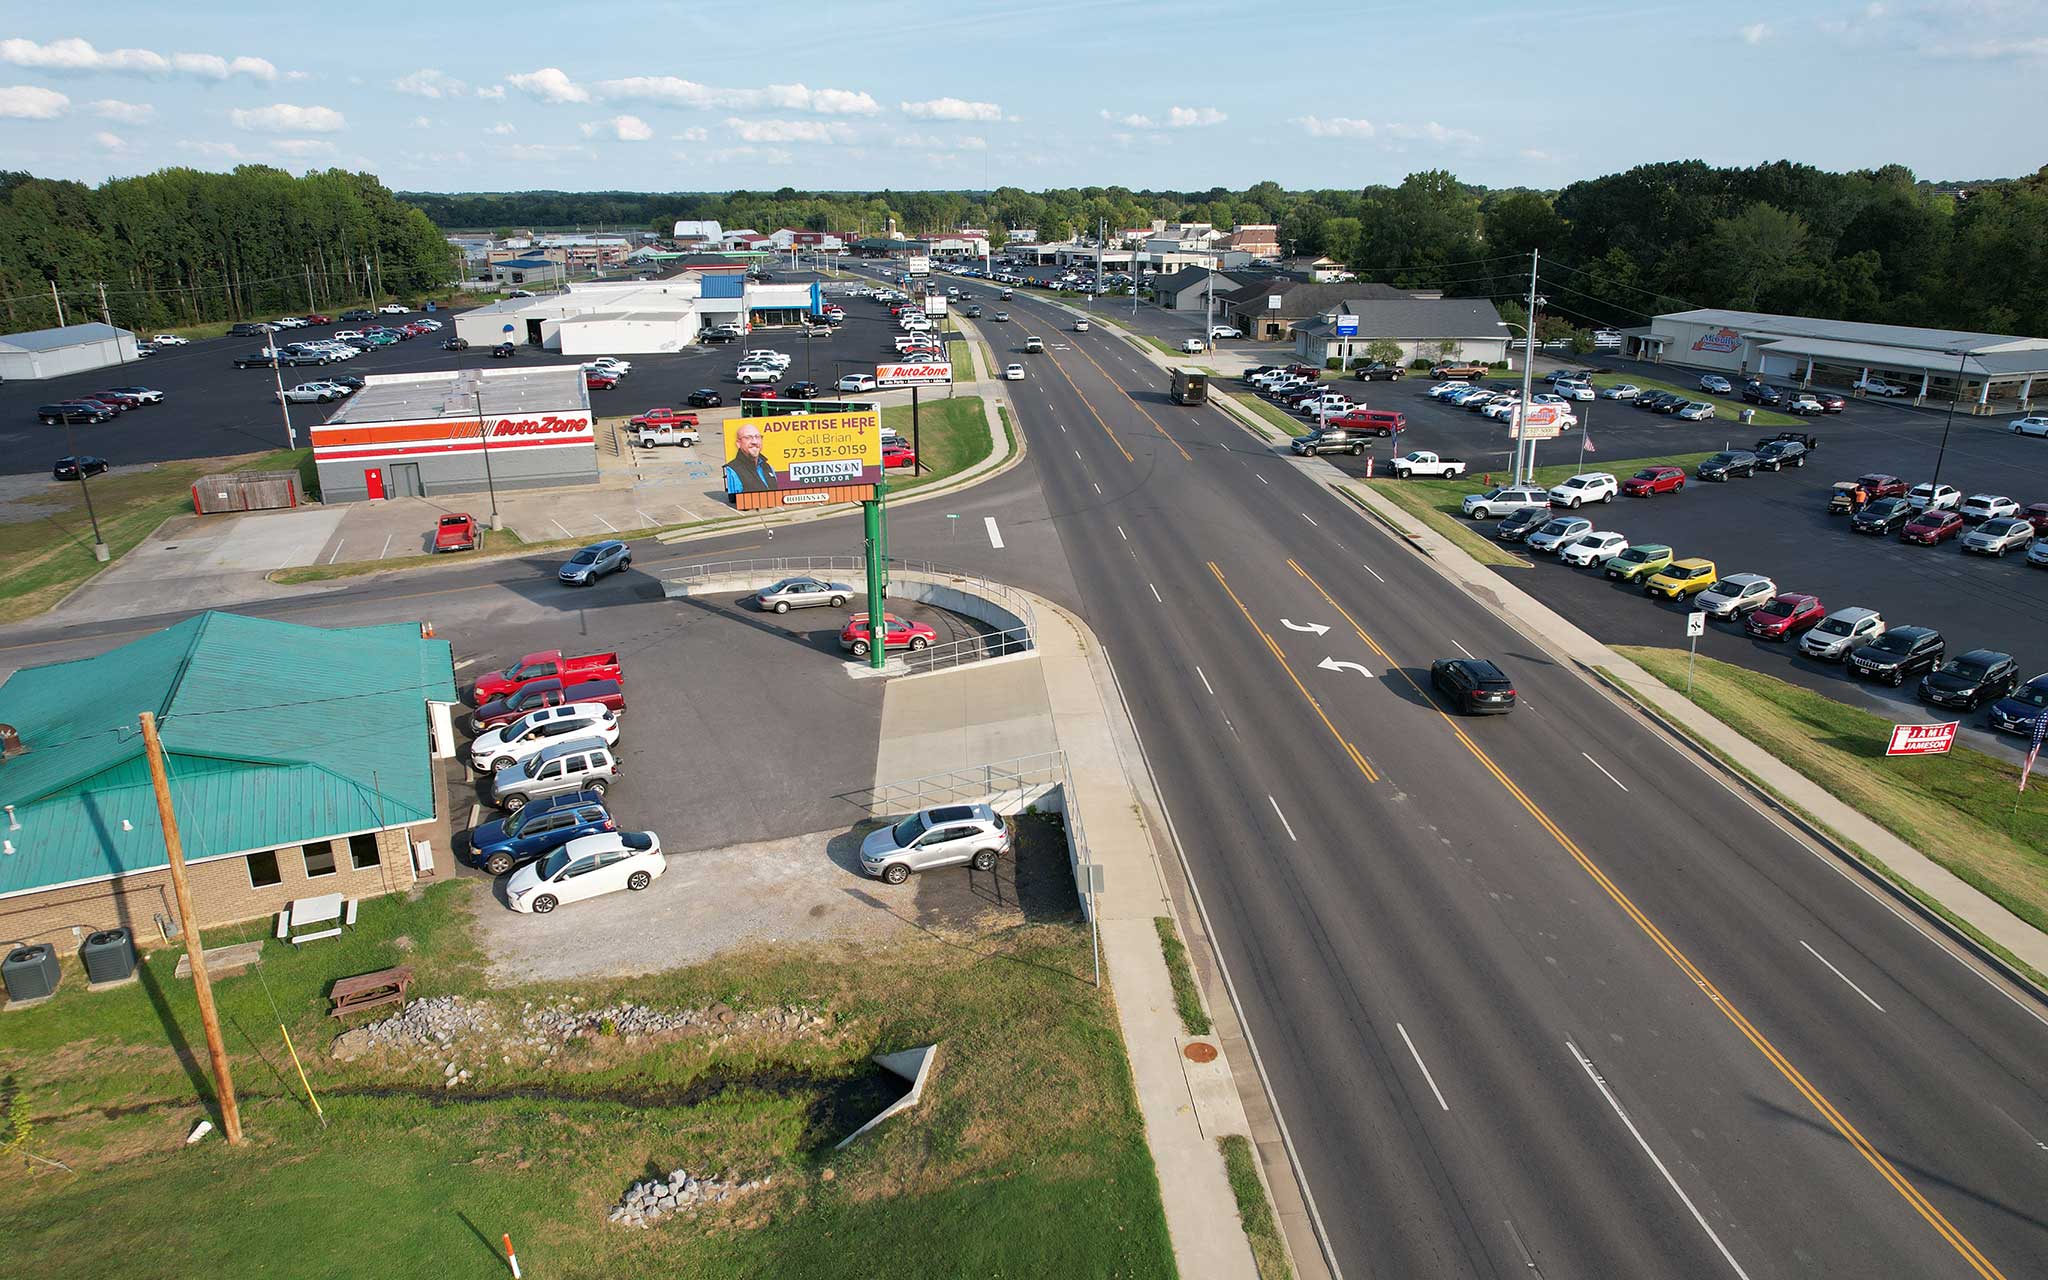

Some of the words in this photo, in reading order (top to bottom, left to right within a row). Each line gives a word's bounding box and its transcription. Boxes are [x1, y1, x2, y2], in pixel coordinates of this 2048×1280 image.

[892, 366, 948, 377] AutoZone
[493, 416, 588, 436] AutoZone
[763, 419, 838, 433] ADVERTISE
[842, 416, 876, 429] HERE
[797, 434, 820, 445] Call
[822, 434, 852, 444] Brian
[783, 444, 867, 459] 573-513-0159
[793, 462, 859, 476] ROBINSON
[804, 475, 850, 484] OUTDOOR
[1910, 727, 1951, 738] JAMIE
[1905, 741, 1947, 750] JAMESON
